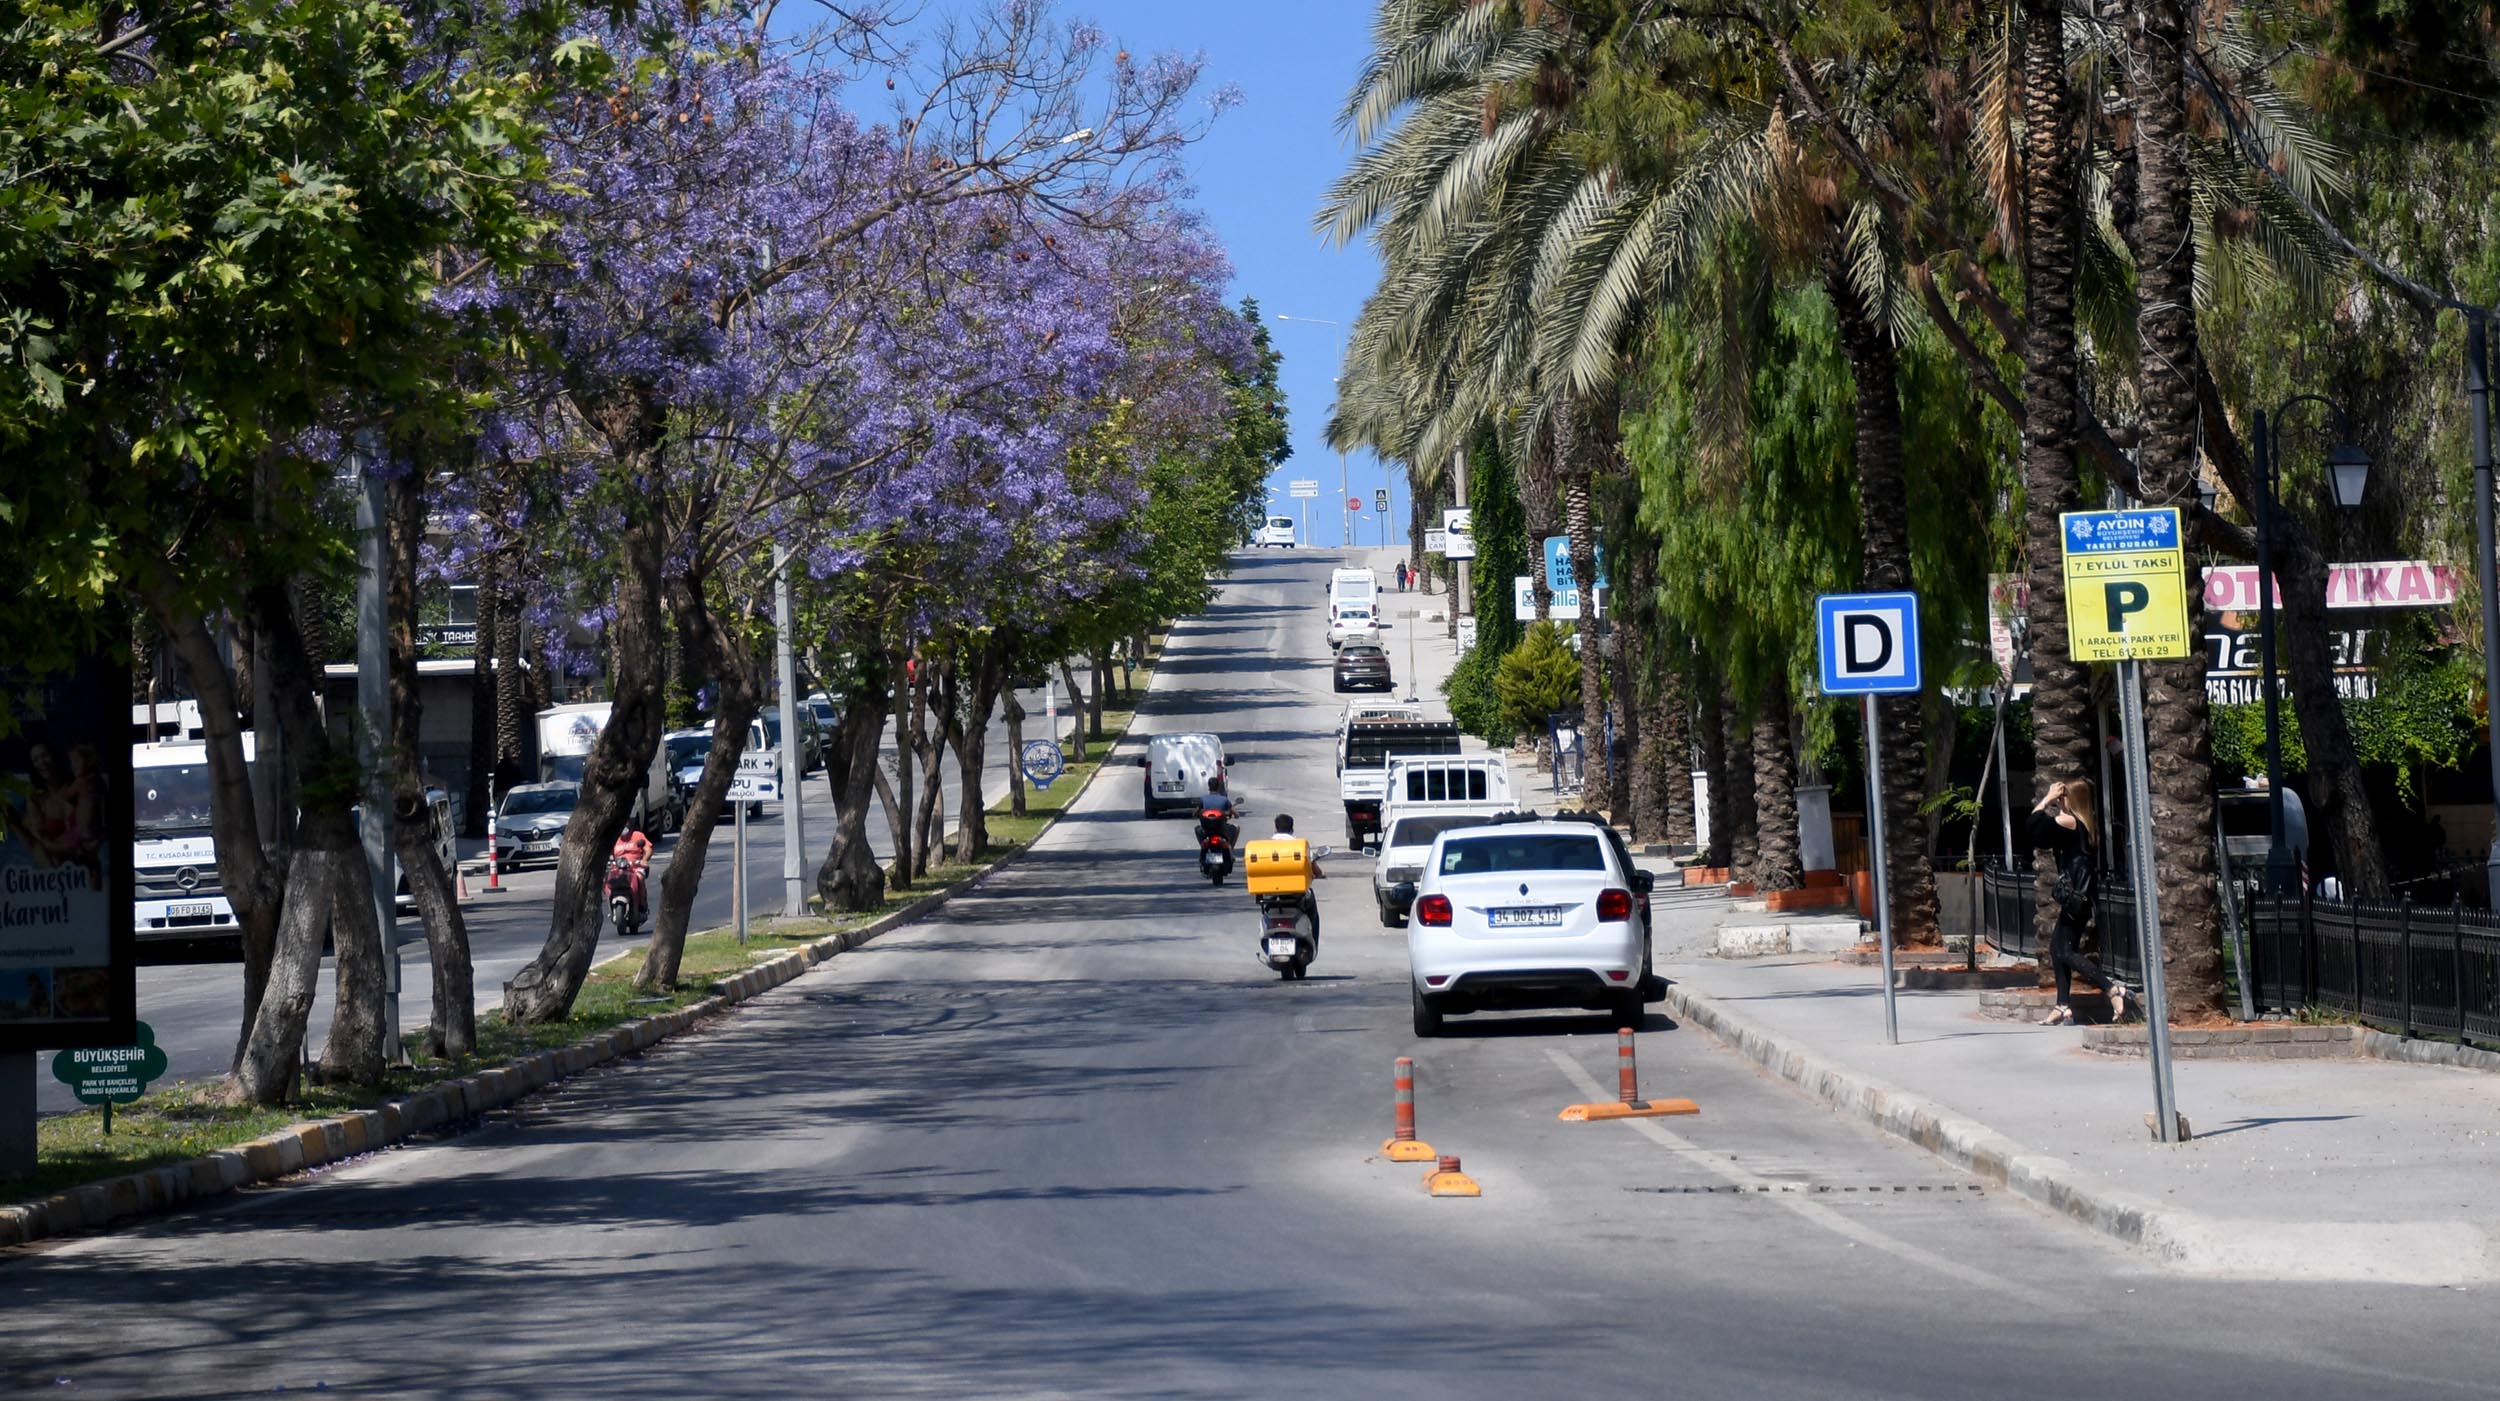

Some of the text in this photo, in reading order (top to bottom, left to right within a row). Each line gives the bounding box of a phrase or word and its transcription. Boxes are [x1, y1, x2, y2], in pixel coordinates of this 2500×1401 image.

[2096, 518, 2145, 530] AYDIN
[2085, 539, 2159, 551] TAKSİ DURAĞI
[1555, 557, 1572, 567] HA
[2074, 557, 2172, 572] 7 EYLÜL TAKSİ
[1556, 567, 1573, 576] HA
[1556, 576, 1575, 586] BİT
[2104, 581, 2149, 632] P
[1843, 614, 1893, 674] D
[2080, 633, 2180, 646] 1 ARAÇLIK PARK YERİ
[2093, 646, 2169, 658] TEL: 612 16 29
[2230, 679, 2252, 705] 614
[732, 779, 751, 789] PU
[6, 866, 87, 897] Güneşin
[1495, 910, 1509, 922] 34
[1538, 909, 1558, 920] 413
[73, 1047, 145, 1064] BÜYÜKŞEHİR
[91, 1064, 128, 1073] BELEDİYESİ
